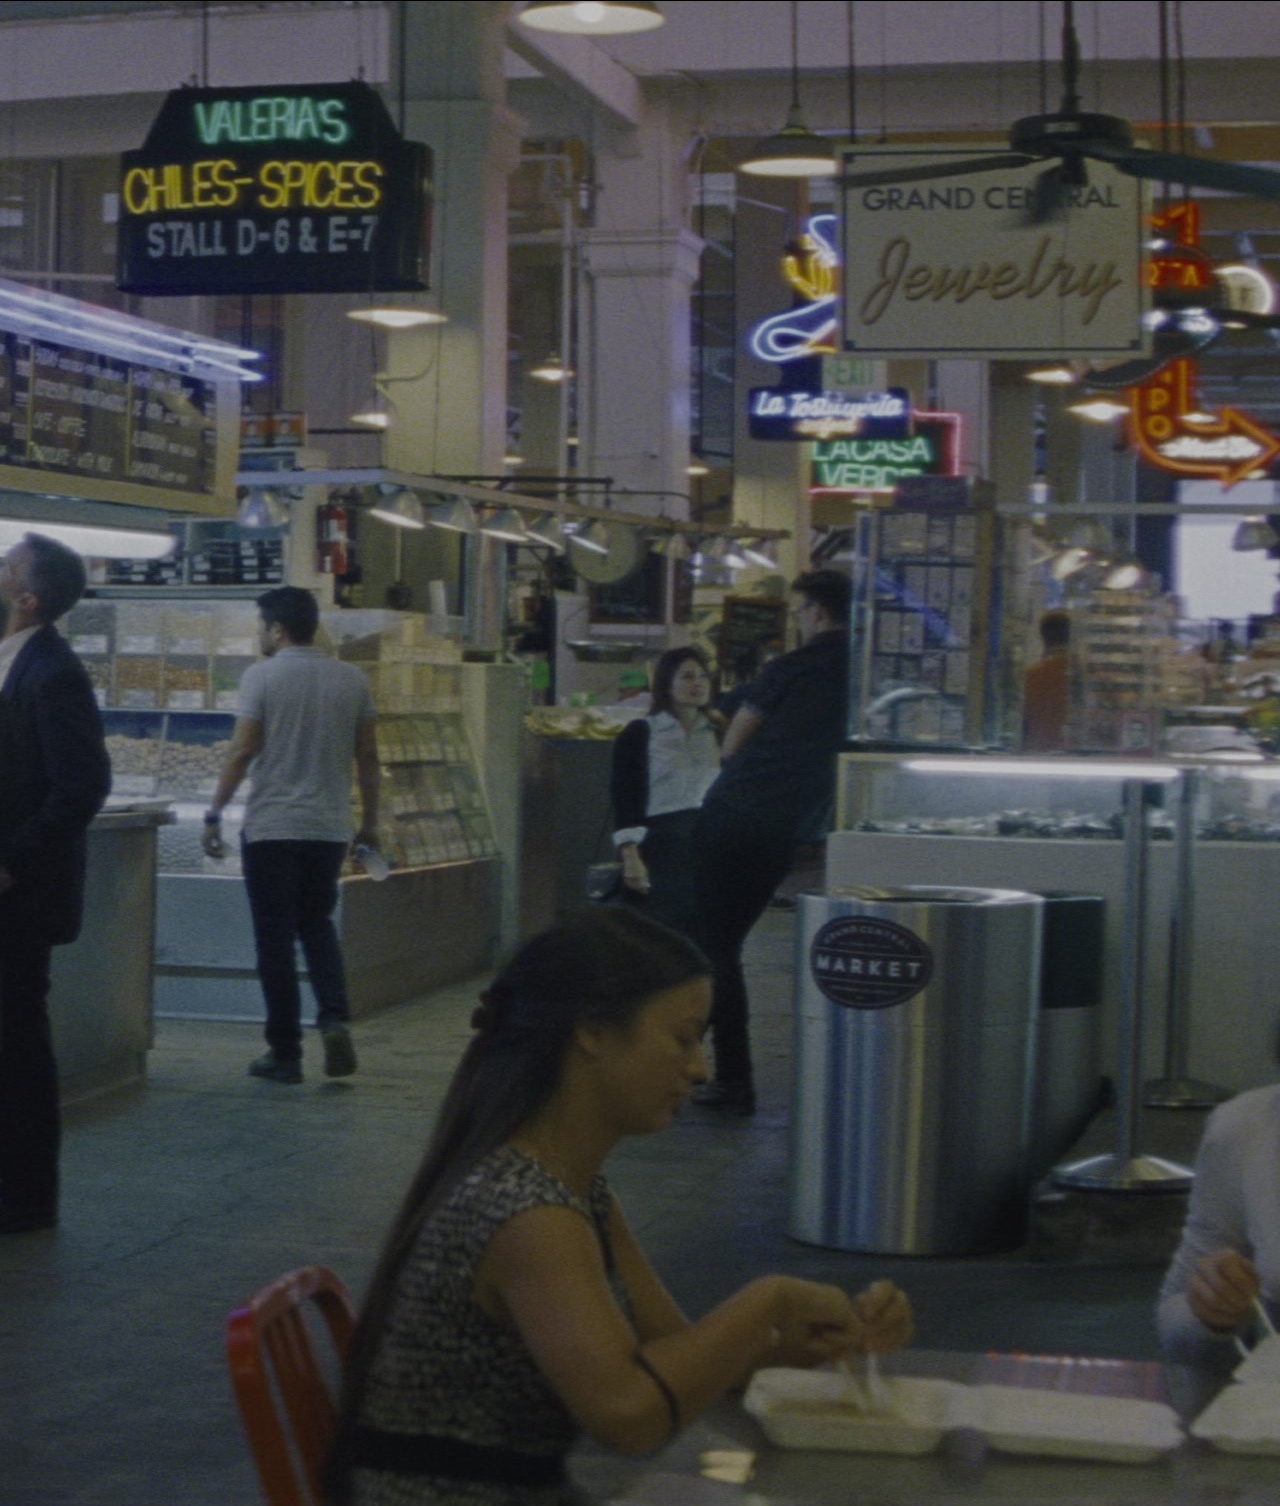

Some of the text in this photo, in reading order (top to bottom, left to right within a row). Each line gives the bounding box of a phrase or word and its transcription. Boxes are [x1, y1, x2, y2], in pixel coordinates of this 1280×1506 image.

[195, 96, 349, 144] VALERIA'S
[259, 160, 383, 209] SPICES
[863, 186, 975, 211] GRAND
[147, 215, 379, 258] STALL D-6 & E-7
[860, 236, 1122, 325] Jewelry
[816, 954, 922, 978] MARKET
